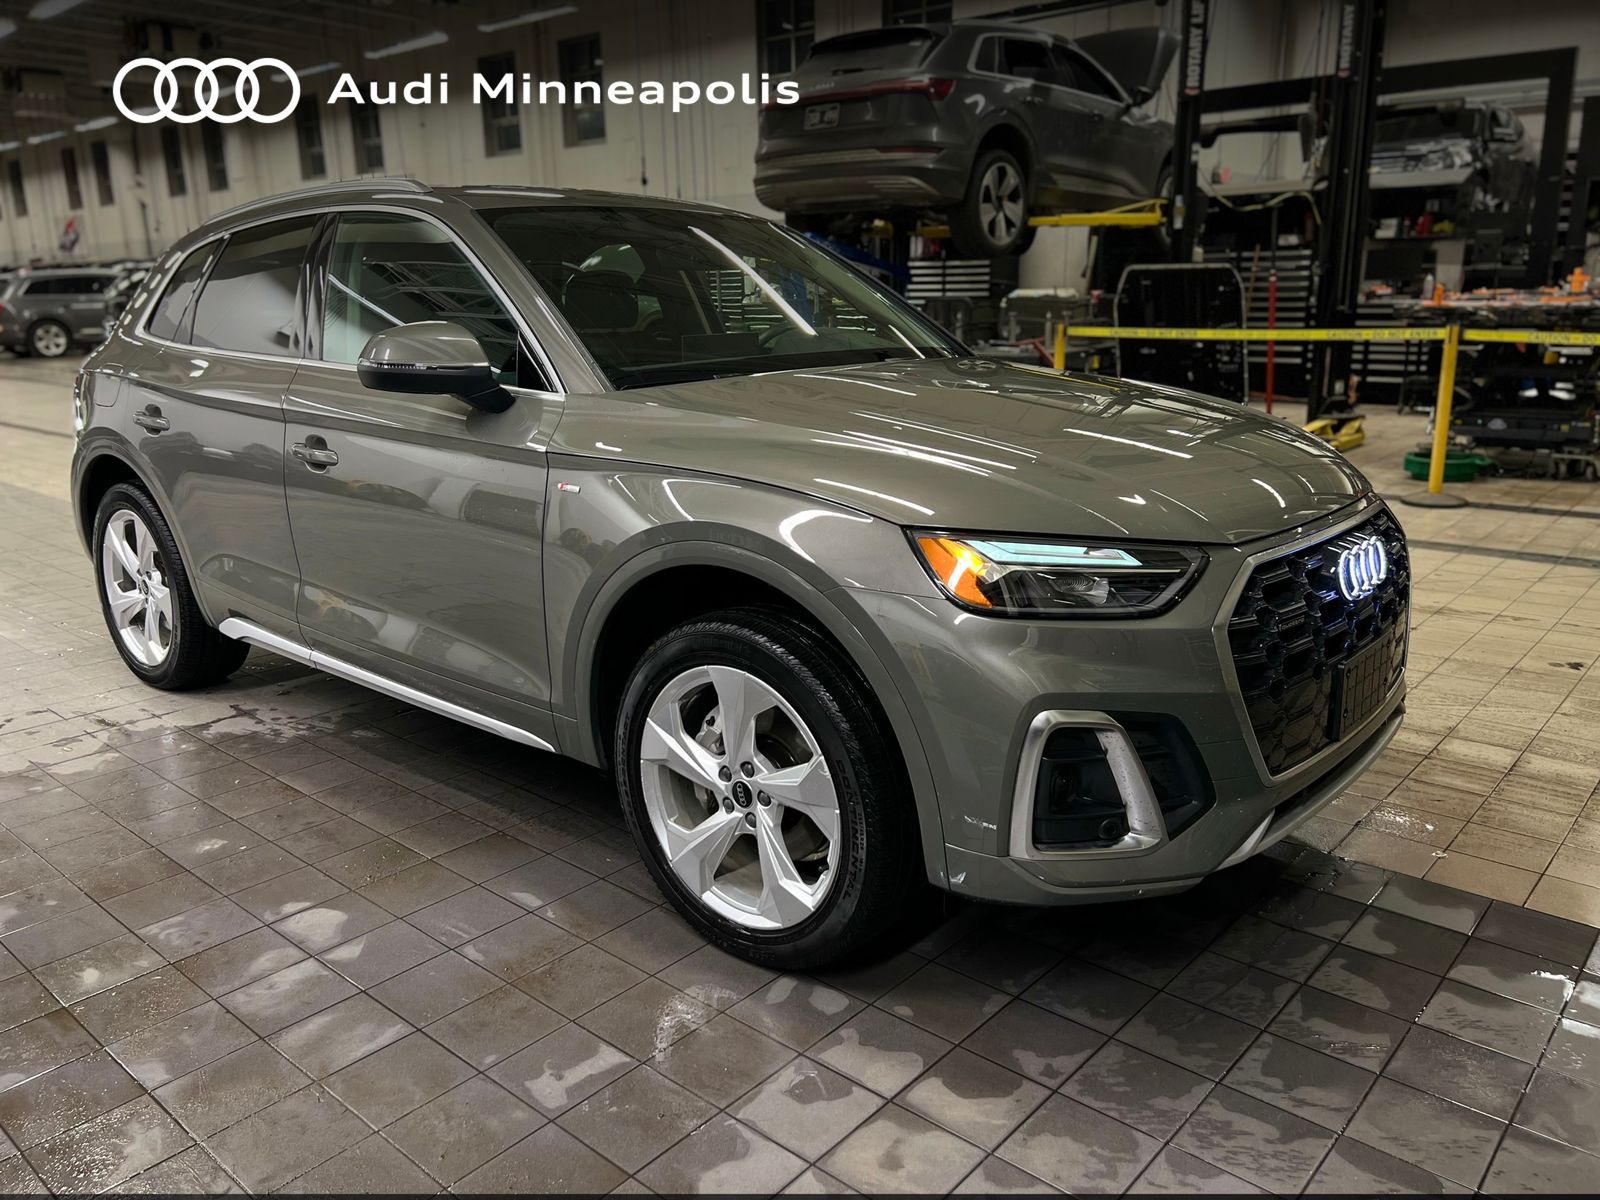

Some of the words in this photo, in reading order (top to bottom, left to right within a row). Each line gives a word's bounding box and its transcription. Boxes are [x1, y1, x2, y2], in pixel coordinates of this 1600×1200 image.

[1190, 0, 1205, 23] LIF
[1186, 27, 1203, 87] ROTARY
[1340, 4, 1354, 69] ROTARY
[1327, 329, 1362, 339] CAUTION
[1410, 328, 1439, 338] ENTER
[1529, 332, 1570, 344] CAUTION
[838, 760, 860, 900] CONTINENTAL
